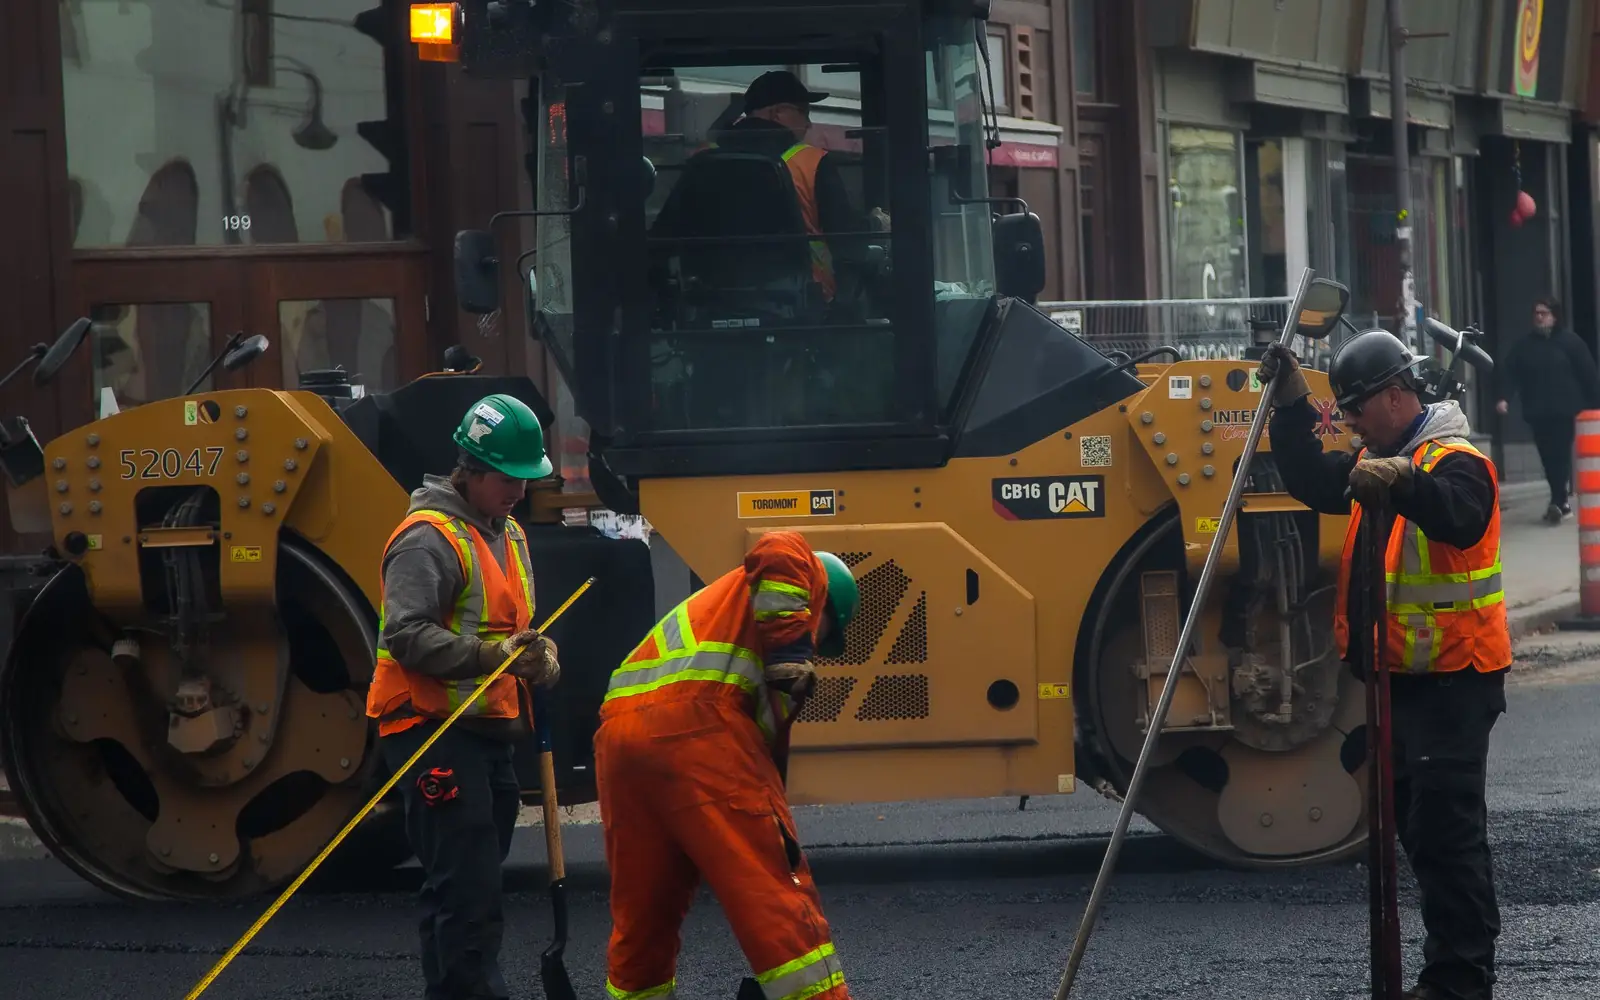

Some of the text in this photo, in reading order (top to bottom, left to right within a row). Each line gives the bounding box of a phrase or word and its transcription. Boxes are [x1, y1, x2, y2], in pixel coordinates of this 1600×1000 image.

[222, 215, 251, 231] 199
[120, 446, 225, 480] 52047
[752, 496, 833, 510] TOROMONT CAT
[1001, 481, 1099, 513] CB16 CAT
